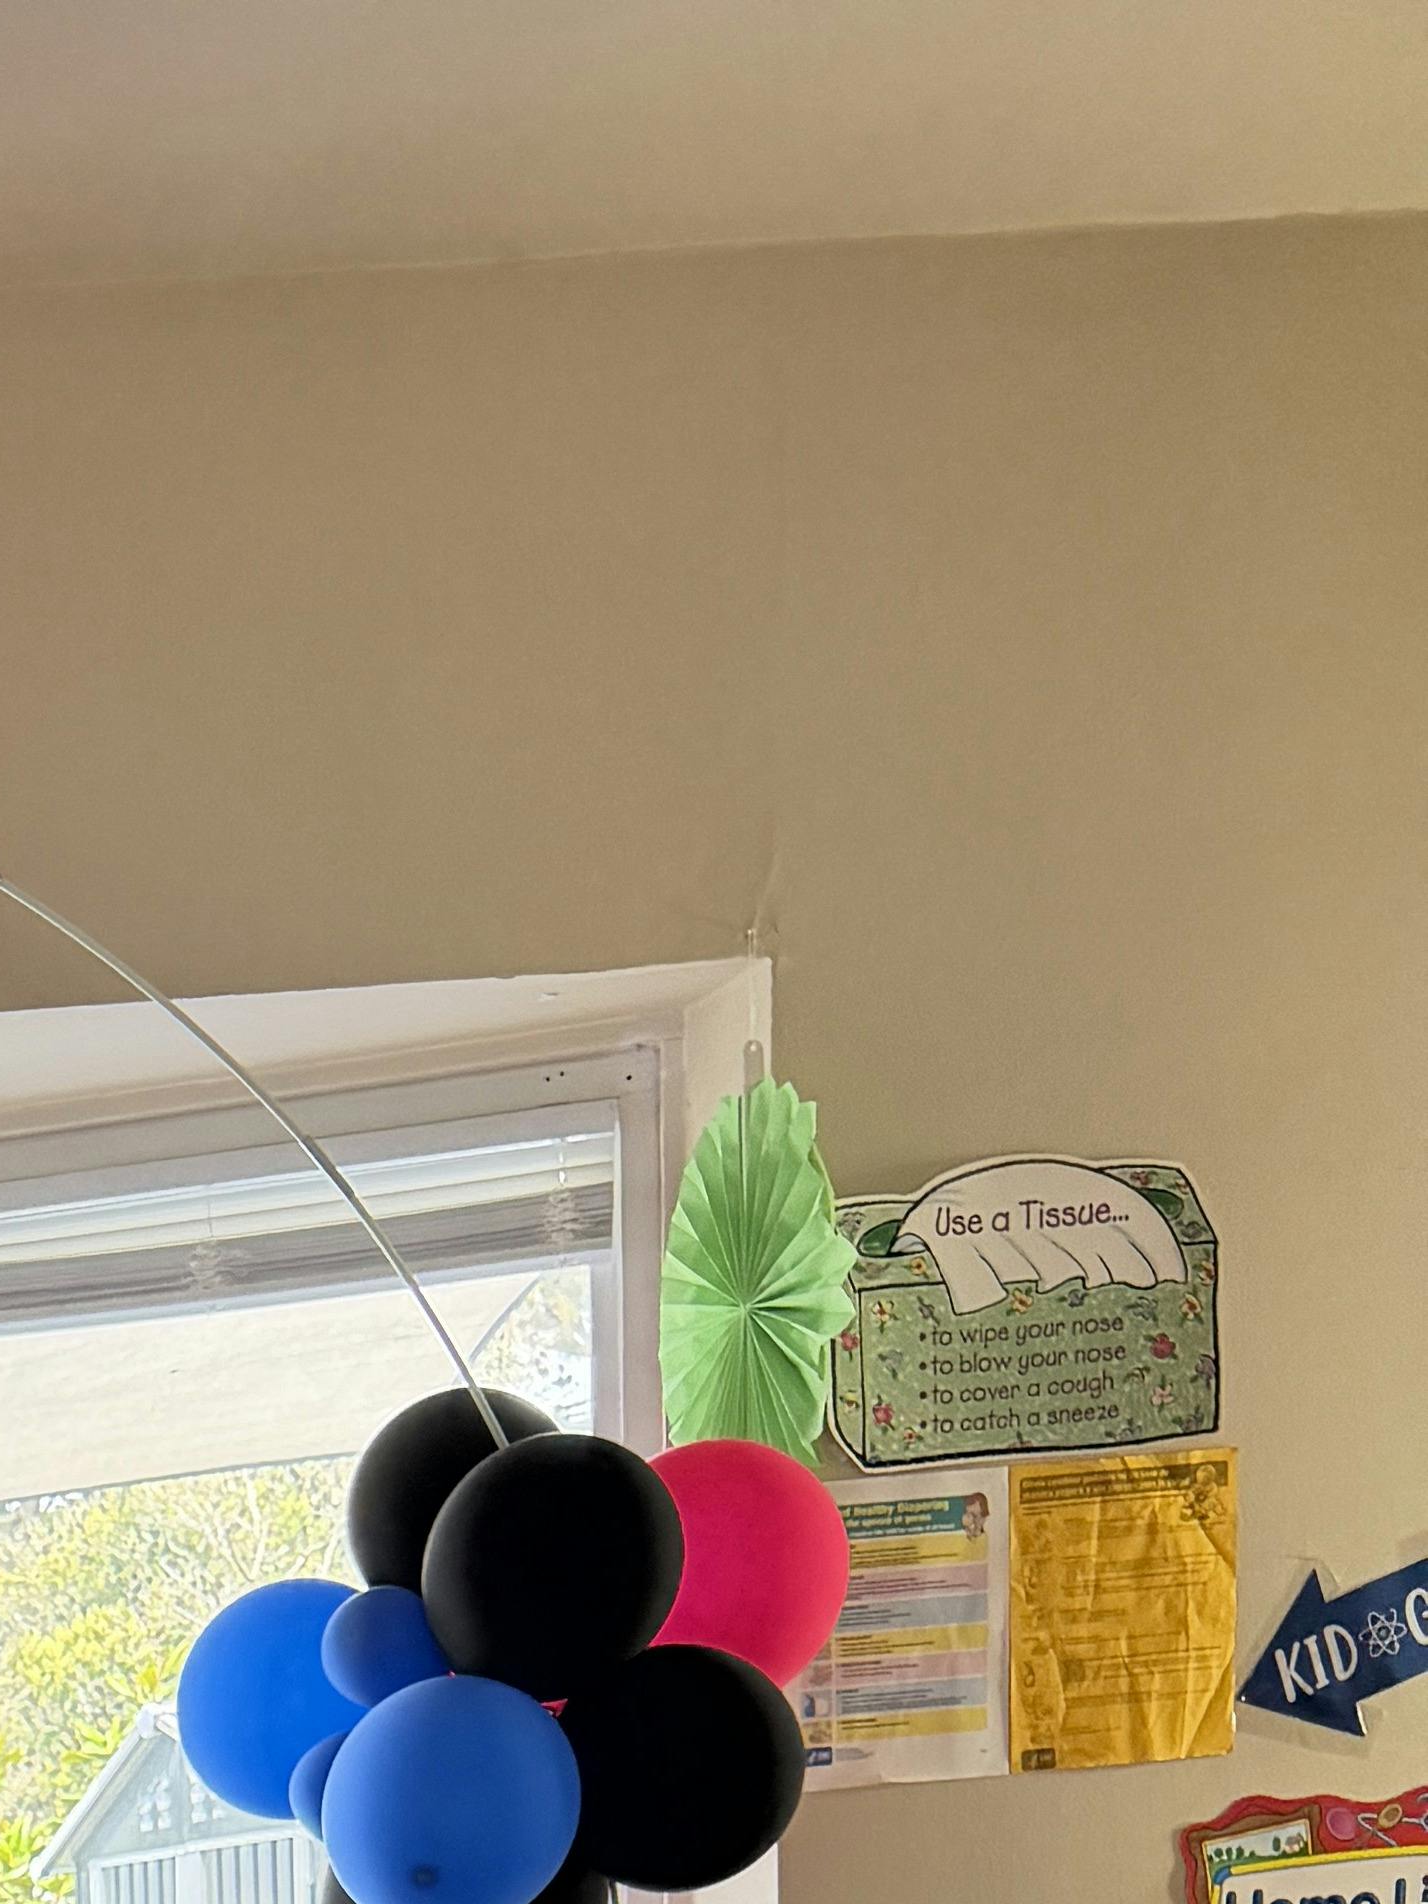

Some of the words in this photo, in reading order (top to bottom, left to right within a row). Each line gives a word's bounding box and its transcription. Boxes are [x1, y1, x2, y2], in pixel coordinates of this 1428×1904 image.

[935, 1206, 984, 1236] Use
[992, 1211, 1010, 1232] a
[1019, 1200, 1130, 1230] Tissue...
[930, 1326, 953, 1346] to
[961, 1322, 1009, 1348] wipe
[1015, 1320, 1066, 1346] your
[1072, 1315, 1124, 1334] nose
[930, 1355, 953, 1376] to
[959, 1352, 1012, 1374] blow
[1018, 1350, 1069, 1375] your
[1074, 1344, 1127, 1364] nose
[930, 1384, 953, 1404] to
[959, 1381, 1021, 1403] cover
[1027, 1381, 1042, 1399] a
[1047, 1369, 1115, 1397] cough
[930, 1413, 954, 1433] to
[960, 1408, 1021, 1431] catch
[1027, 1411, 1042, 1427] a
[1047, 1404, 1120, 1426] sneeze
[1274, 1624, 1358, 1703] KID
